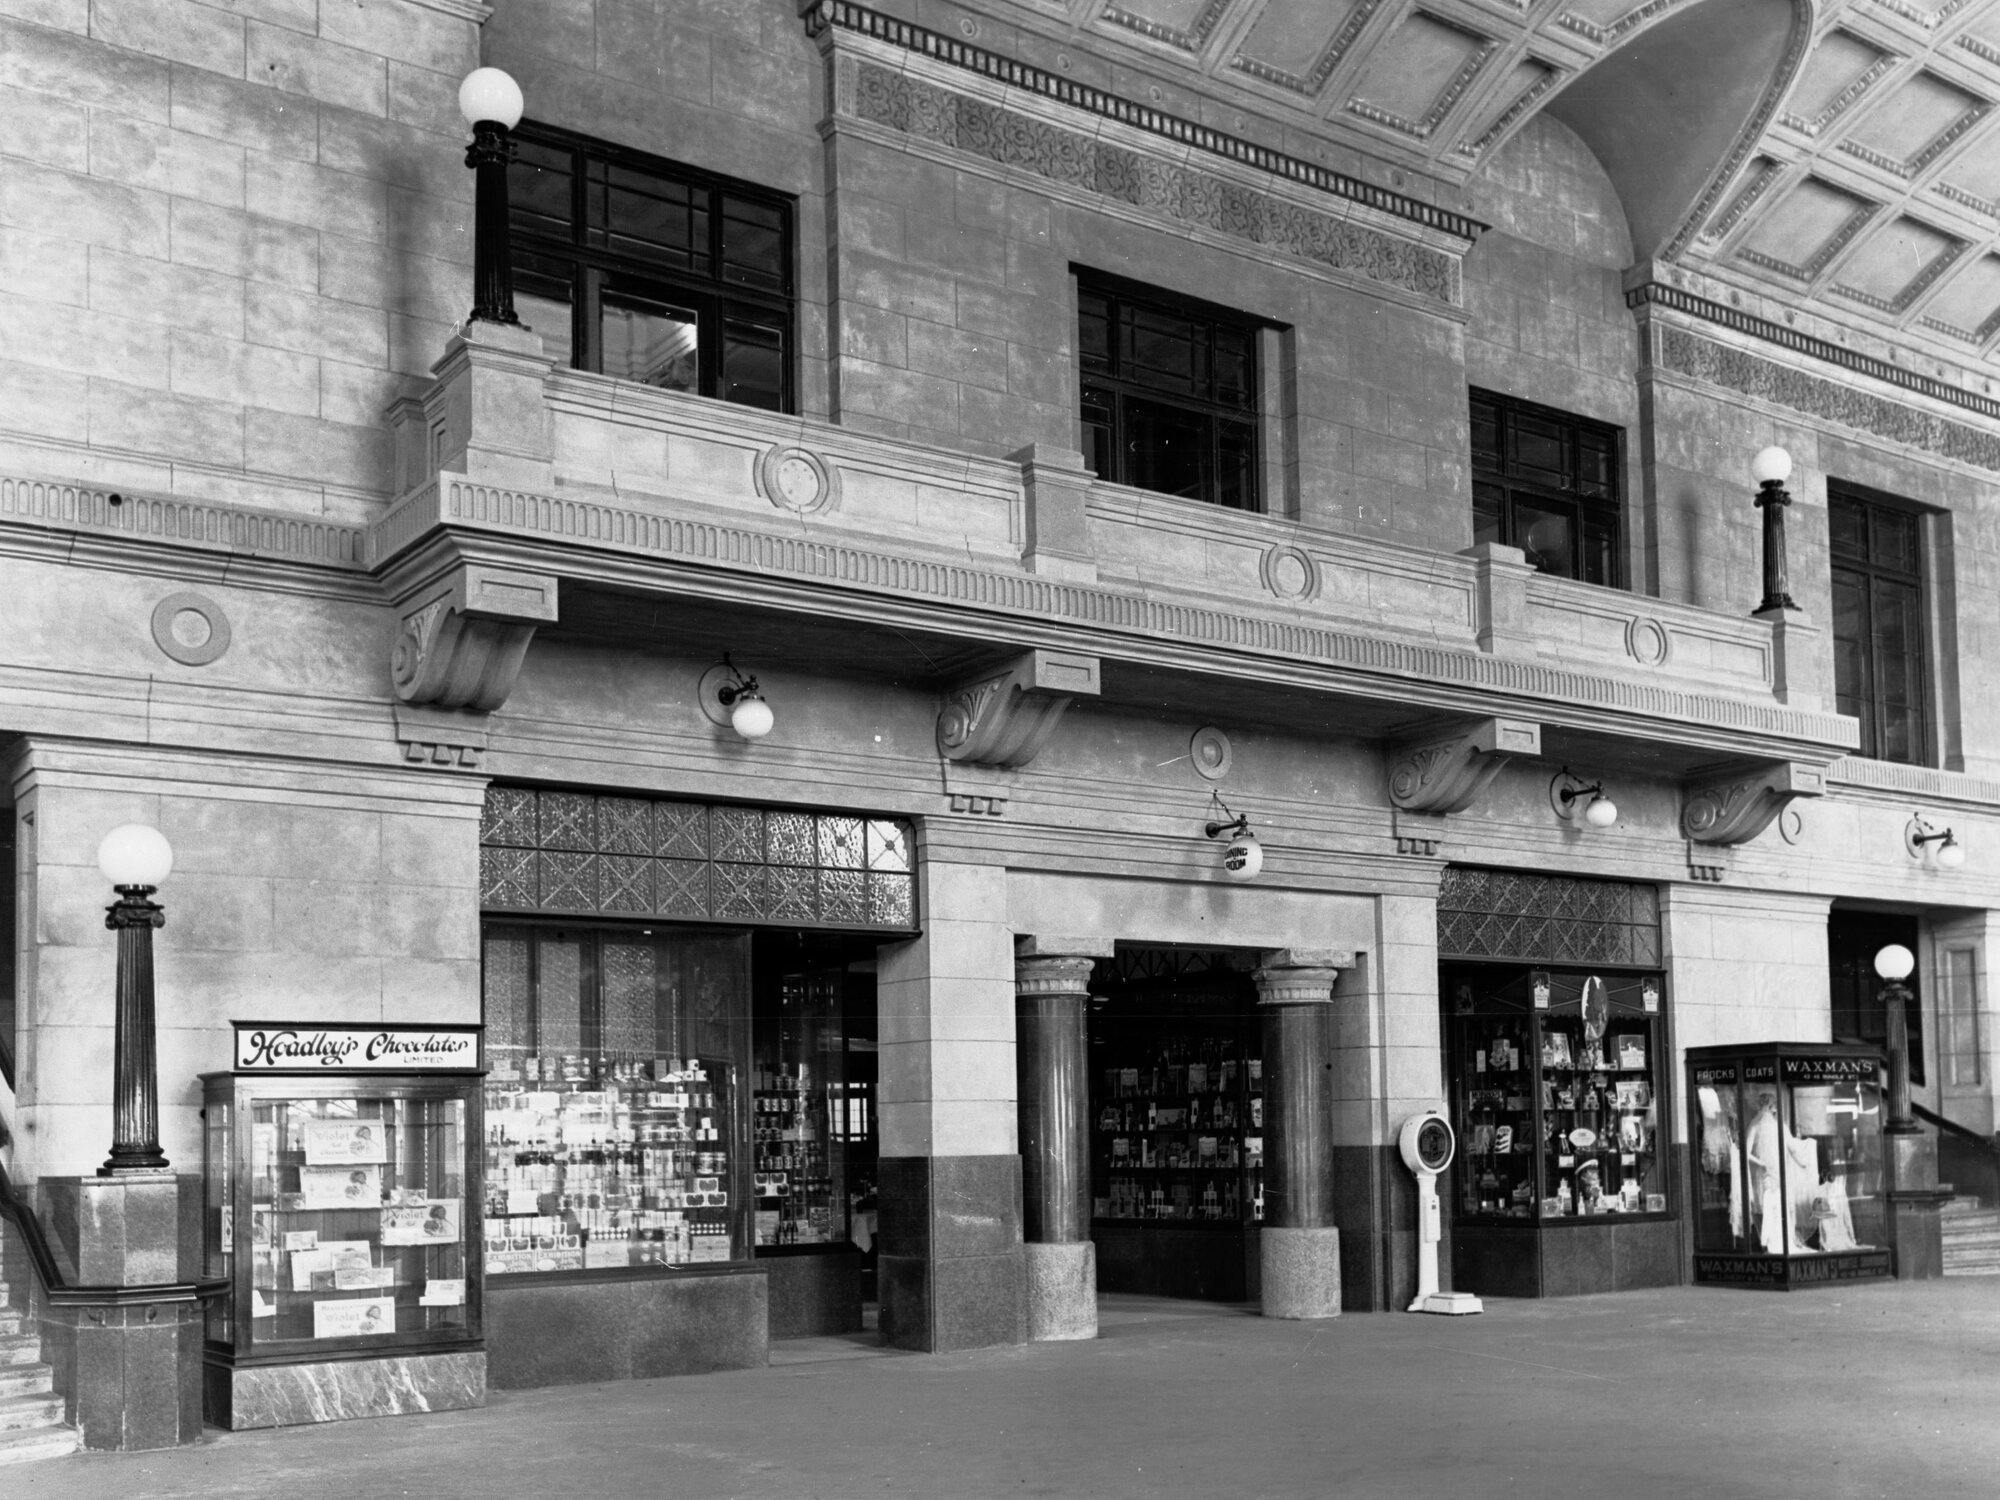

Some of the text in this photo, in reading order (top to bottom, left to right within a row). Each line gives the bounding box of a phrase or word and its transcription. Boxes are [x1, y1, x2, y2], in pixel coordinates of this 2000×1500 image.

[1226, 858, 1245, 870] ROOM
[242, 1031, 469, 1066] Hoadley's Chocolates
[403, 1056, 443, 1064] LIMITED
[1746, 1066, 1774, 1078] COATS
[1786, 1060, 1873, 1073] WAXMAN'S
[1697, 1068, 1735, 1081] FROCKS
[390, 1208, 424, 1219] Violet
[1700, 1259, 1783, 1274] WAXMAN'S
